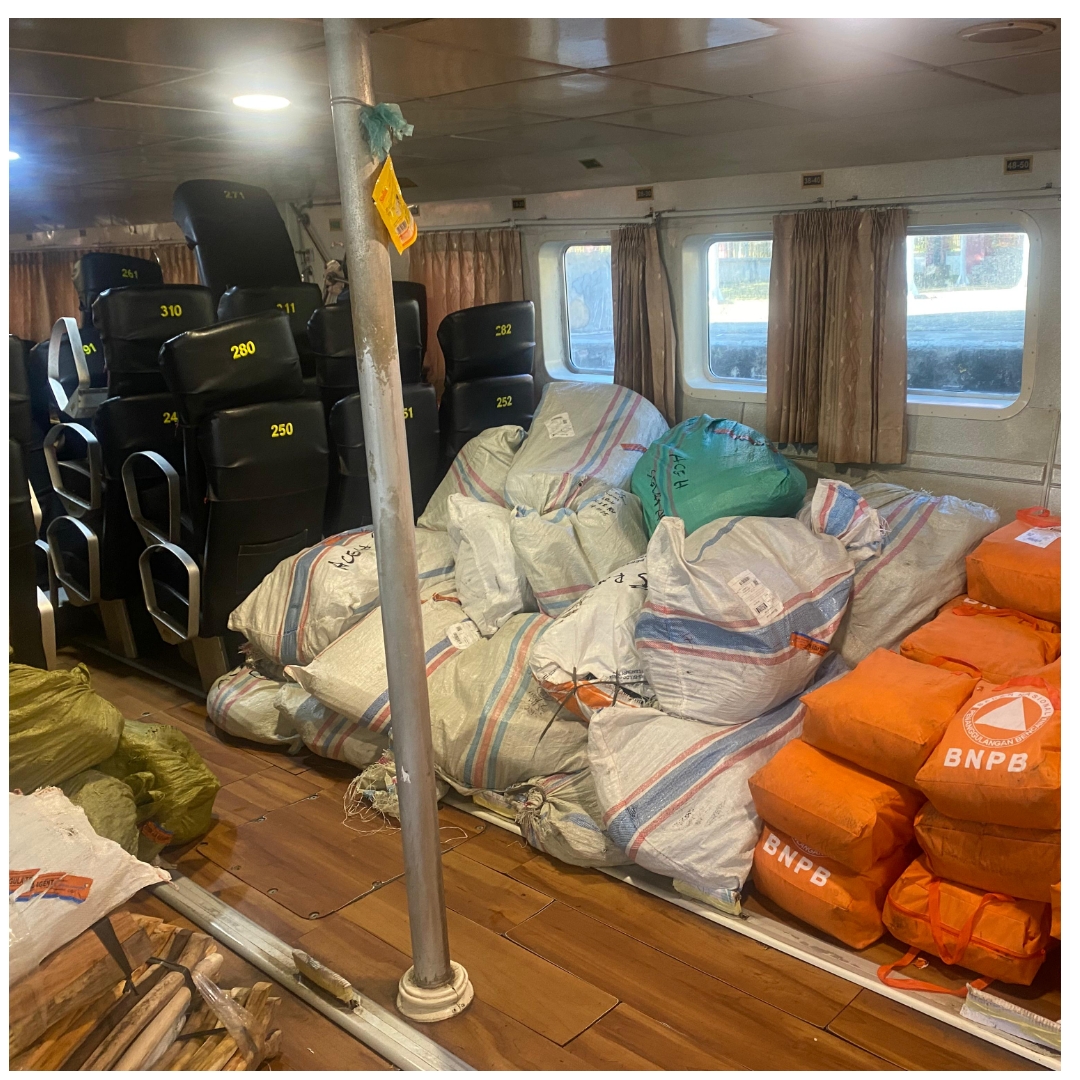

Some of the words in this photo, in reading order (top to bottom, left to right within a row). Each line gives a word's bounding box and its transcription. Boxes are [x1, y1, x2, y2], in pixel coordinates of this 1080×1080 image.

[1007, 160, 1030, 170] 48-50
[122, 268, 138, 279] 261
[160, 304, 182, 318] 310
[230, 340, 256, 360] 280
[496, 395, 513, 409] 252
[270, 422, 294, 437] 250
[943, 747, 1029, 773] BNPB
[762, 832, 831, 887] BNPB
